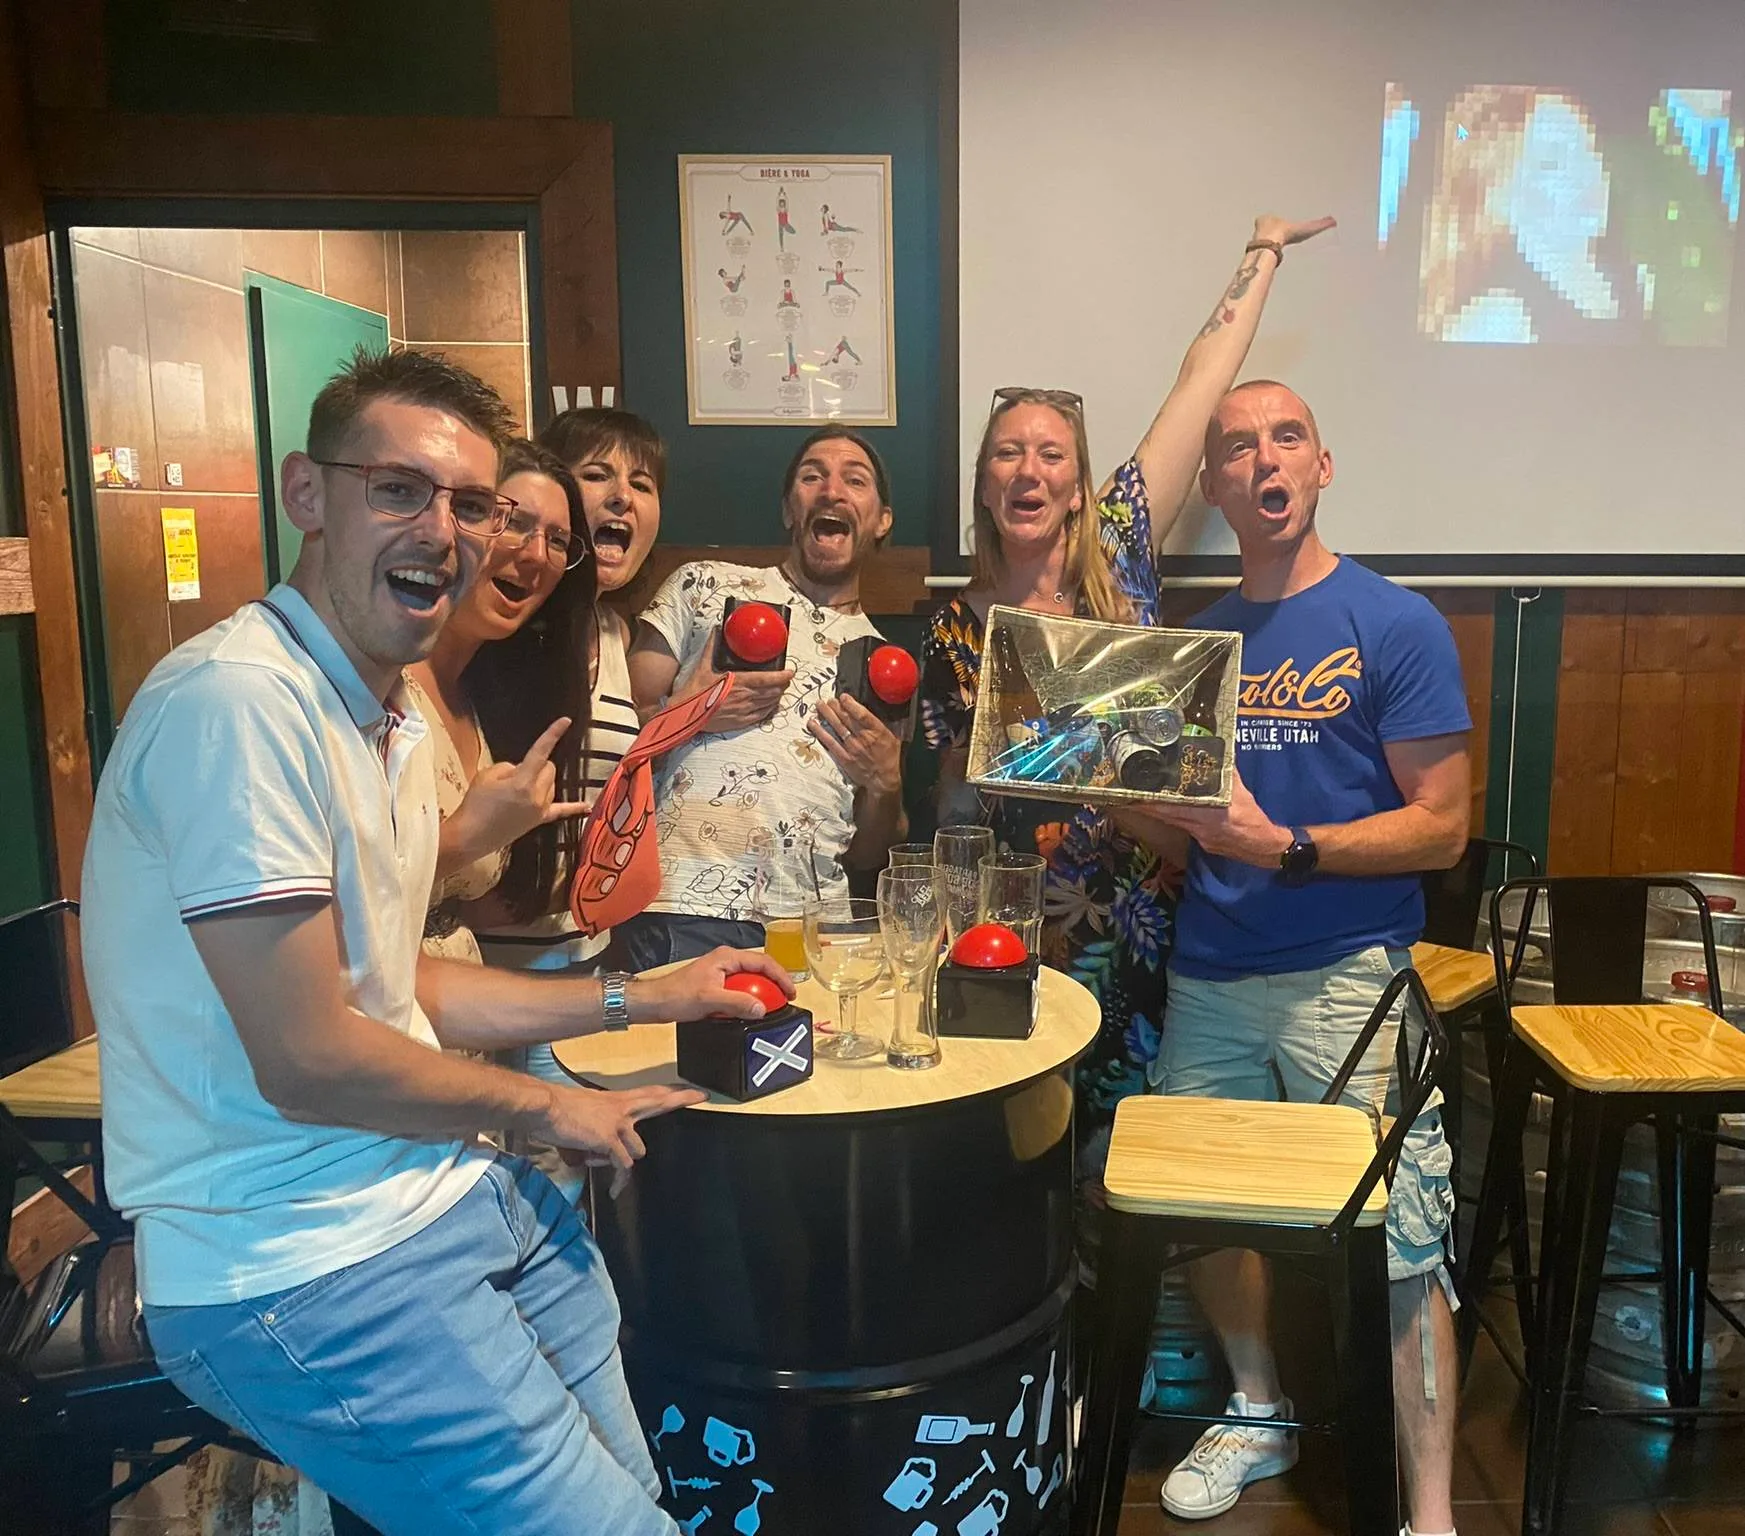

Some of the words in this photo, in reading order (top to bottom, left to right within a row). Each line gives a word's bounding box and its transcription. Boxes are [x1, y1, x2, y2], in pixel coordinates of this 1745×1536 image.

[791, 169, 810, 178] YOGA
[1277, 719, 1299, 728] SINCE
[1235, 727, 1278, 742] NEVILLE
[1284, 728, 1319, 744] UTAH
